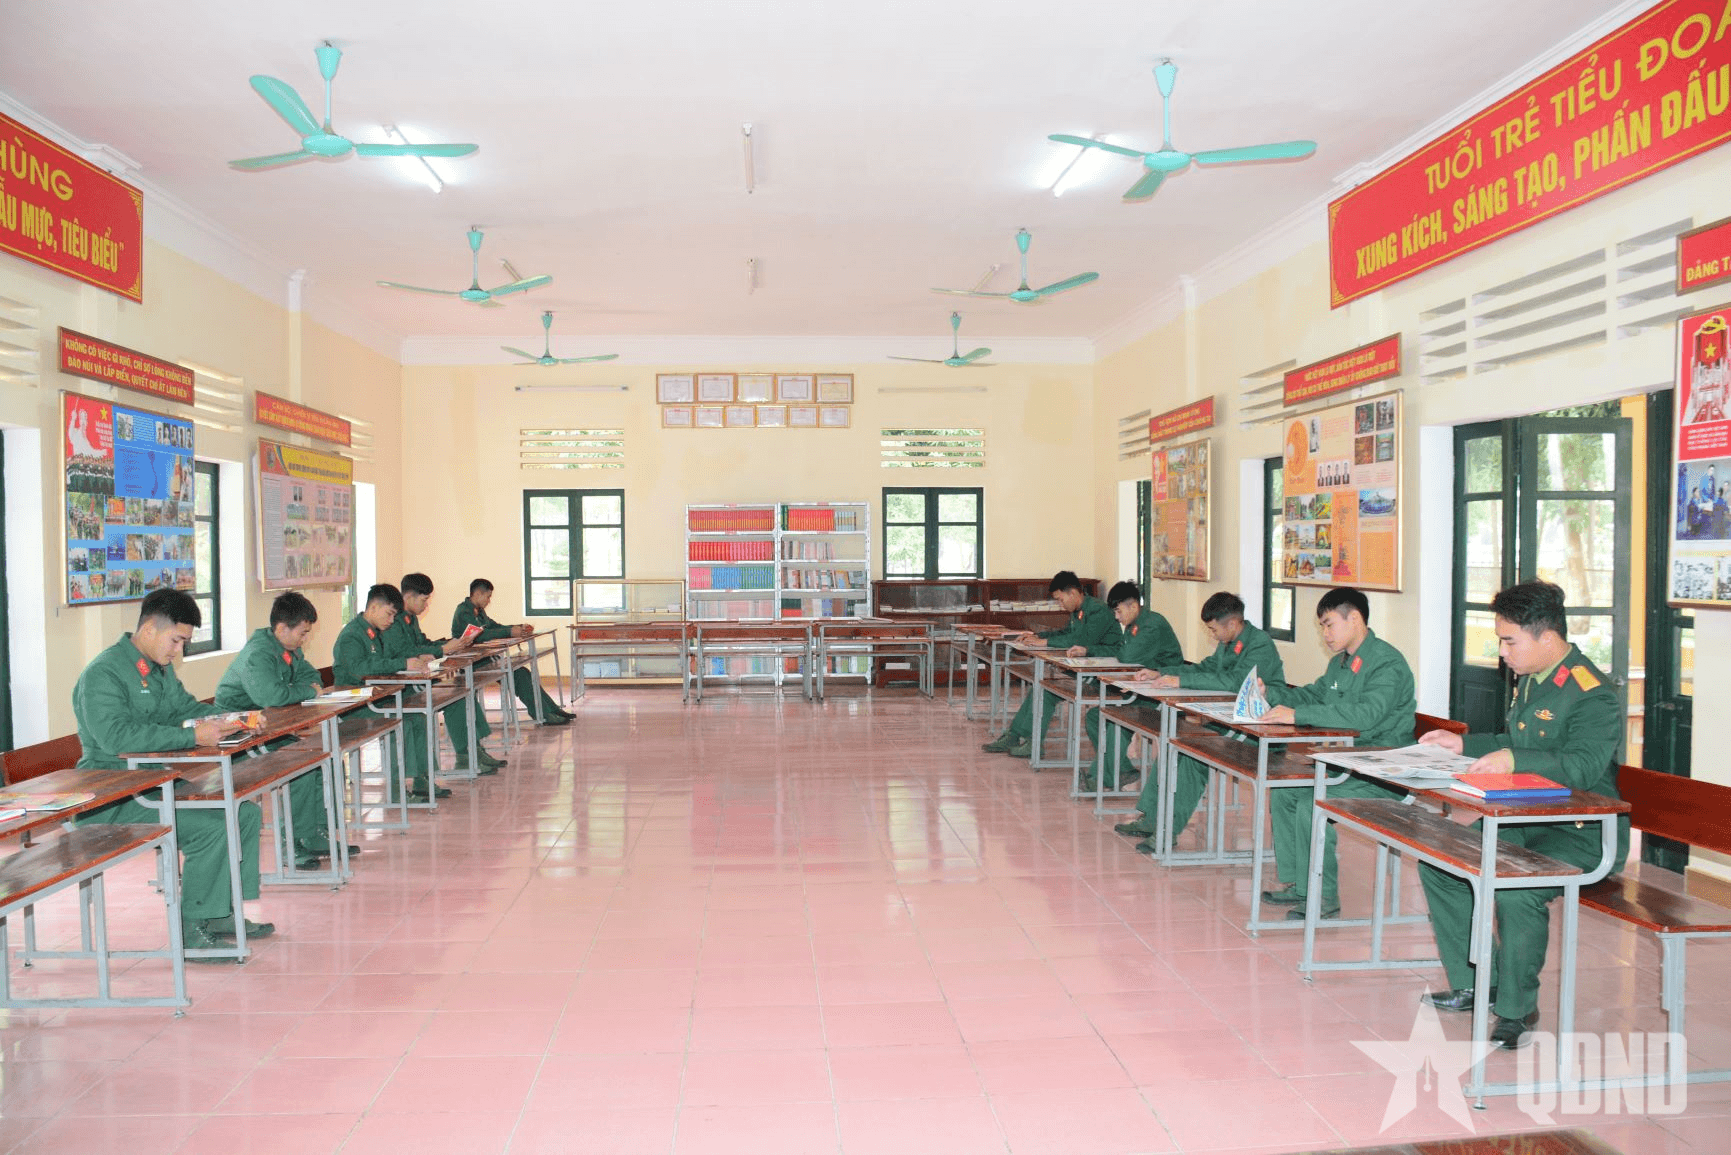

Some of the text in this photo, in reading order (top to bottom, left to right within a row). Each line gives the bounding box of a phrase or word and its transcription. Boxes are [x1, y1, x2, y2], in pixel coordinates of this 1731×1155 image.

[1356, 57, 1730, 279] XUNG KÍCH, SÁNG TẠO, PHẤN ĐẤU
[1425, 129, 1482, 195] TUỔI
[1490, 95, 1541, 159] TRẺ
[1550, 53, 1621, 128] TIỂU
[21, 200, 57, 253] MỰC,
[61, 217, 88, 261] TIÊU
[1721, 255, 1731, 271] T
